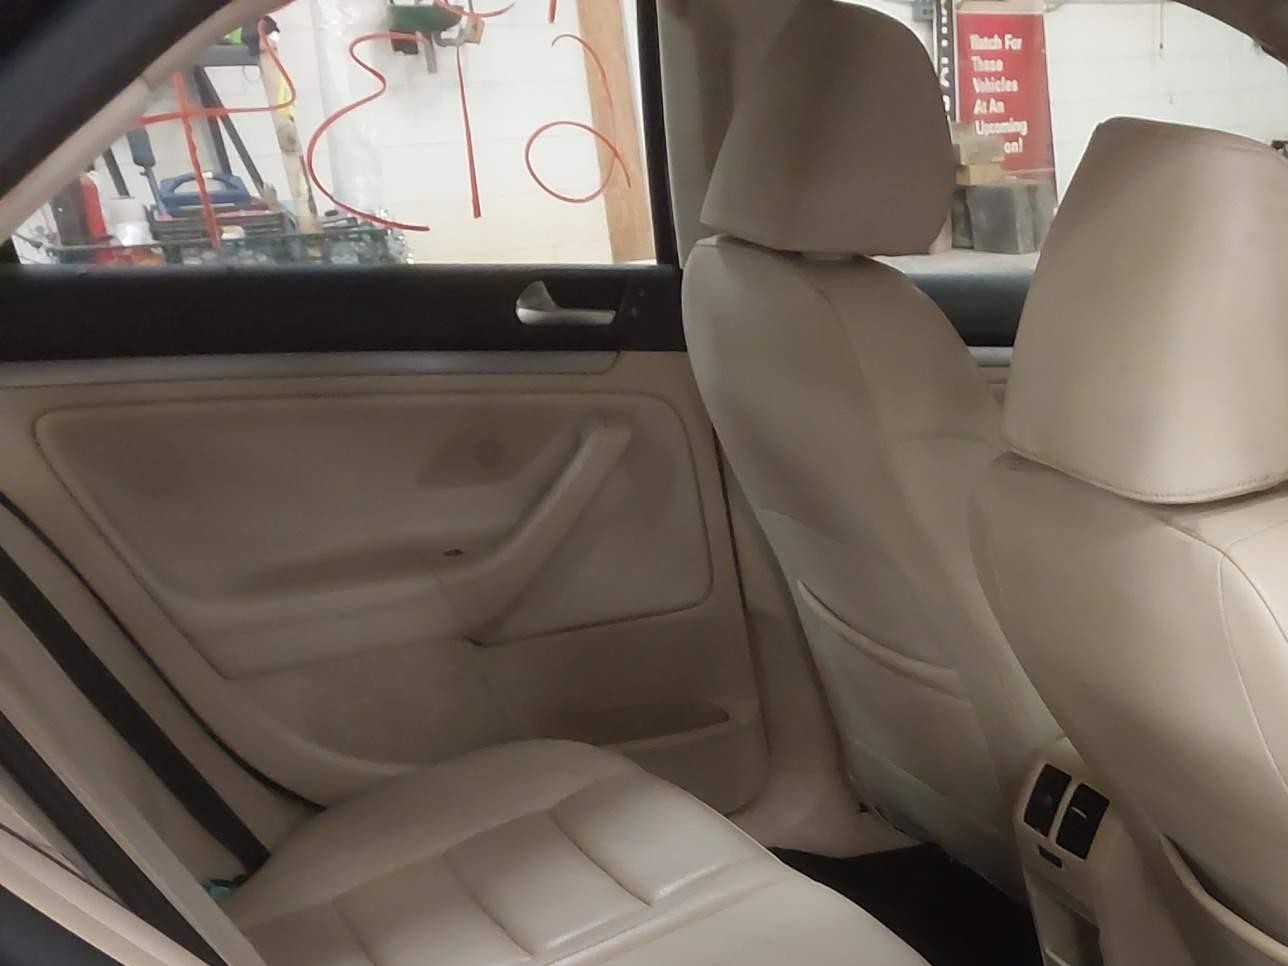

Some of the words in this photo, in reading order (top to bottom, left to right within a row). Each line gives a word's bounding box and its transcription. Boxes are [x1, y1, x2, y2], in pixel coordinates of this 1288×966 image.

[969, 33, 1003, 50] Watch
[1004, 33, 1023, 50] For
[971, 55, 1004, 72] These
[972, 76, 1019, 93] Vehicles
[973, 98, 988, 115] At
[989, 97, 1005, 113] An
[975, 116, 1028, 136] Upcoming
